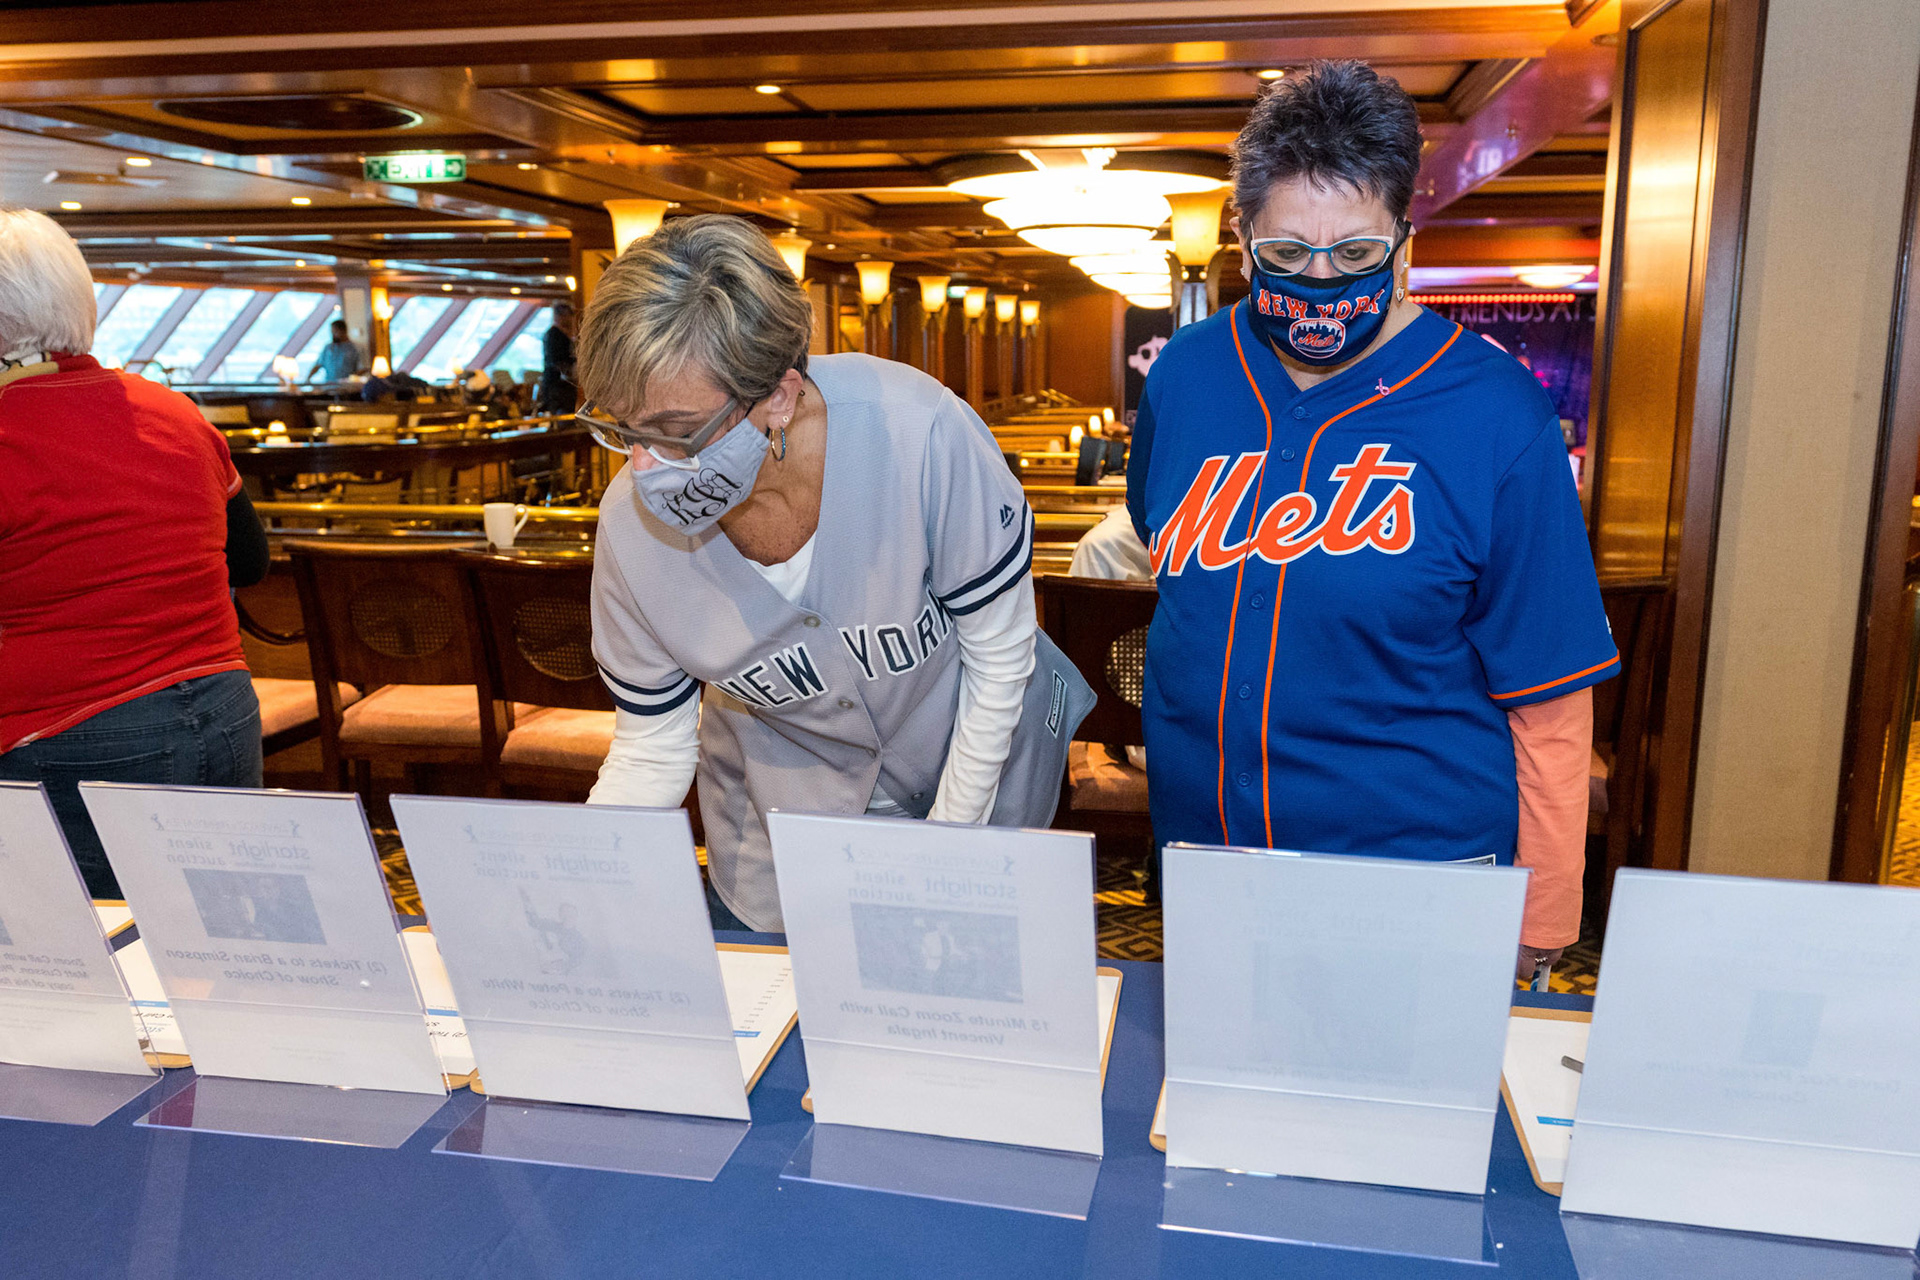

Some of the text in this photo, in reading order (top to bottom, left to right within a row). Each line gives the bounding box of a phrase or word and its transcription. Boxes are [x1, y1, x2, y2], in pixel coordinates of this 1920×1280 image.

[1257, 288, 1385, 321] NEW YORK
[1298, 332, 1336, 348] Mets
[1149, 443, 1416, 578] Mets
[710, 578, 956, 709] NEW YORK
